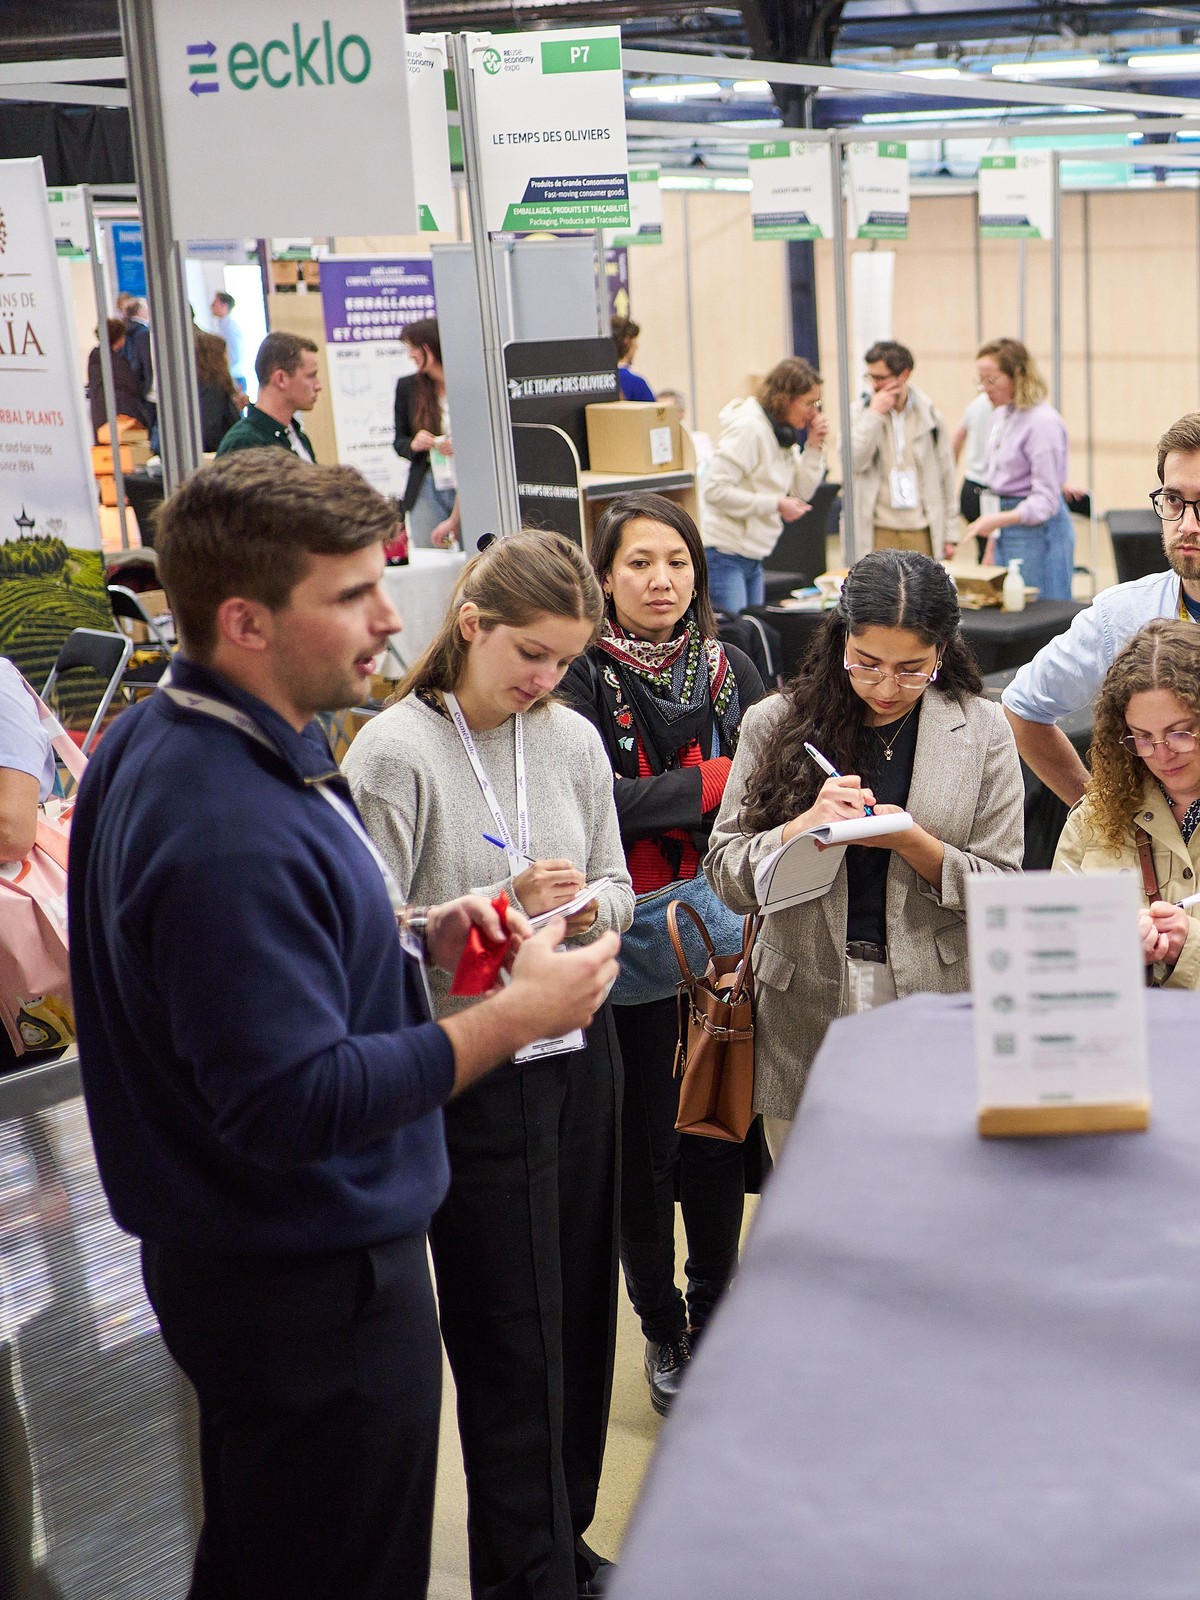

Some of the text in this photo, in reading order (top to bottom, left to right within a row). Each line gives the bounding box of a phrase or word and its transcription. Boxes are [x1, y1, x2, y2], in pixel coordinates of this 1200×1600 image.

[228, 20, 371, 90] ecklo
[570, 46, 590, 63] P7
[407, 59, 435, 68] conomy
[408, 66, 421, 74] xpo
[493, 128, 610, 145] LE TEMPS DES OLIVIERS
[531, 176, 624, 188] Produits de Grande Consommation
[544, 188, 625, 200] Fast-moving consumer goods
[514, 202, 628, 216] EMBALLAGES, PRODUITS ET TRAÇABILITÉ
[560, 216, 584, 226] Products
[585, 216, 596, 225] and
[596, 215, 629, 225] Traceability
[20, 293, 36, 308] DE
[344, 294, 434, 312] EMBALLAGES
[524, 373, 616, 396] LE TEMPS DES OLIVIERS
[0, 409, 64, 427] RBAL PLANTS
